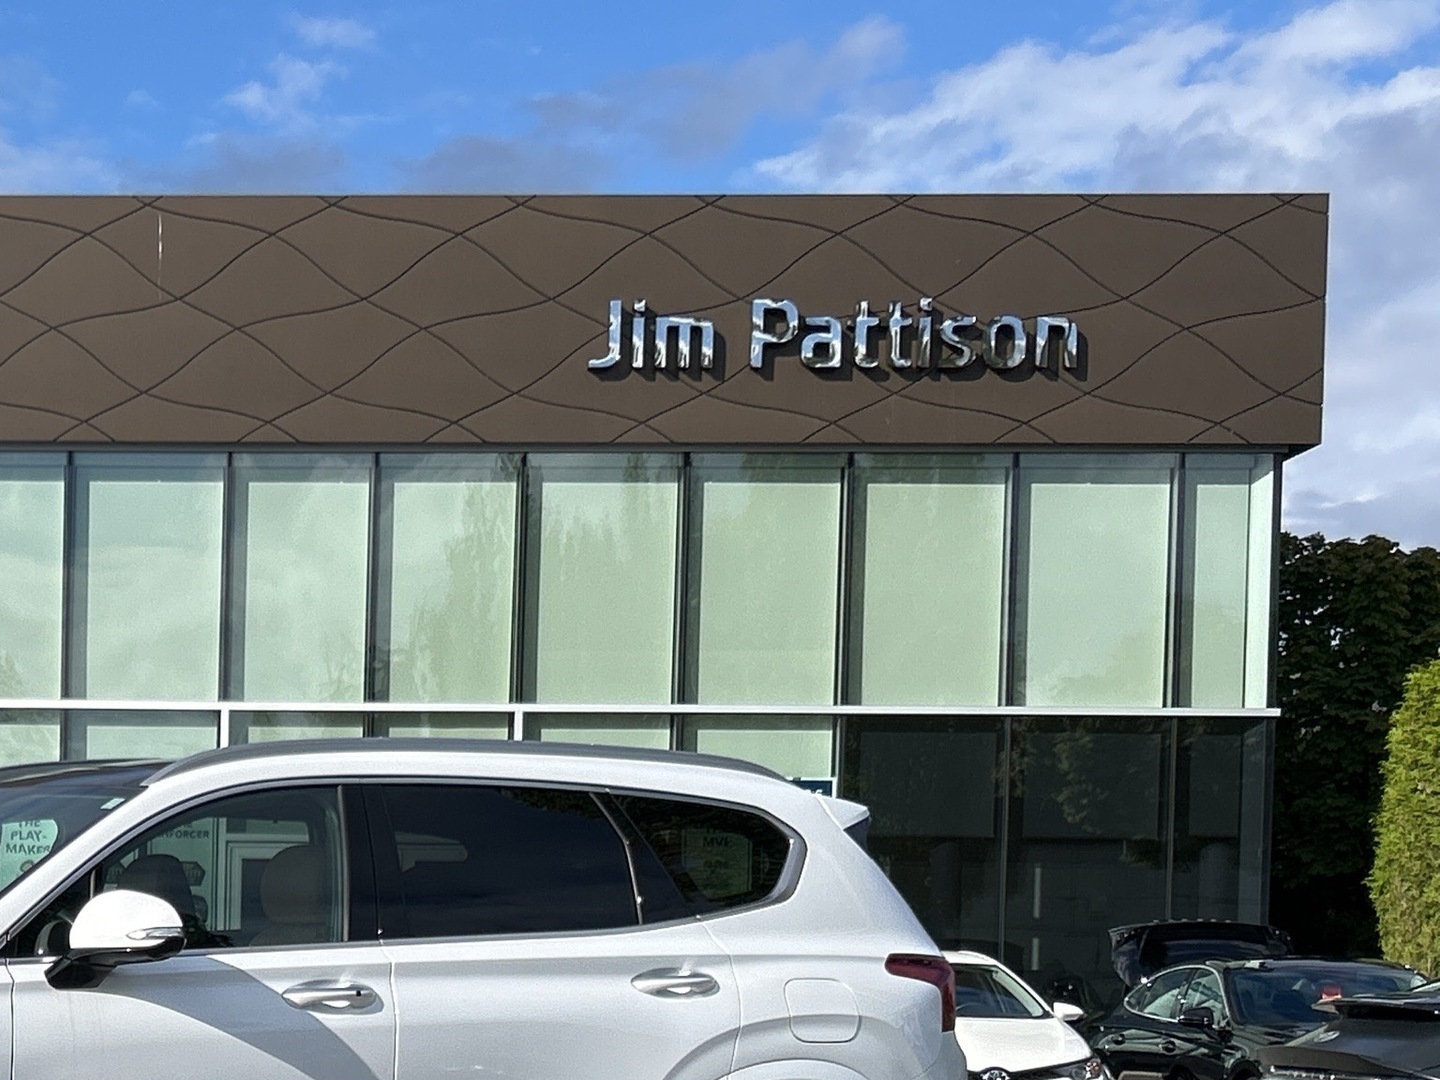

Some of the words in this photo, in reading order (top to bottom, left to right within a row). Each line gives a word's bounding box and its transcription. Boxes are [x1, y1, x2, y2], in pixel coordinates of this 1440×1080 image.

[588, 298, 714, 368] Jim
[749, 298, 1078, 368] Pattison
[10, 830, 47, 841] PLAY-
[6, 843, 50, 855] MAKER
